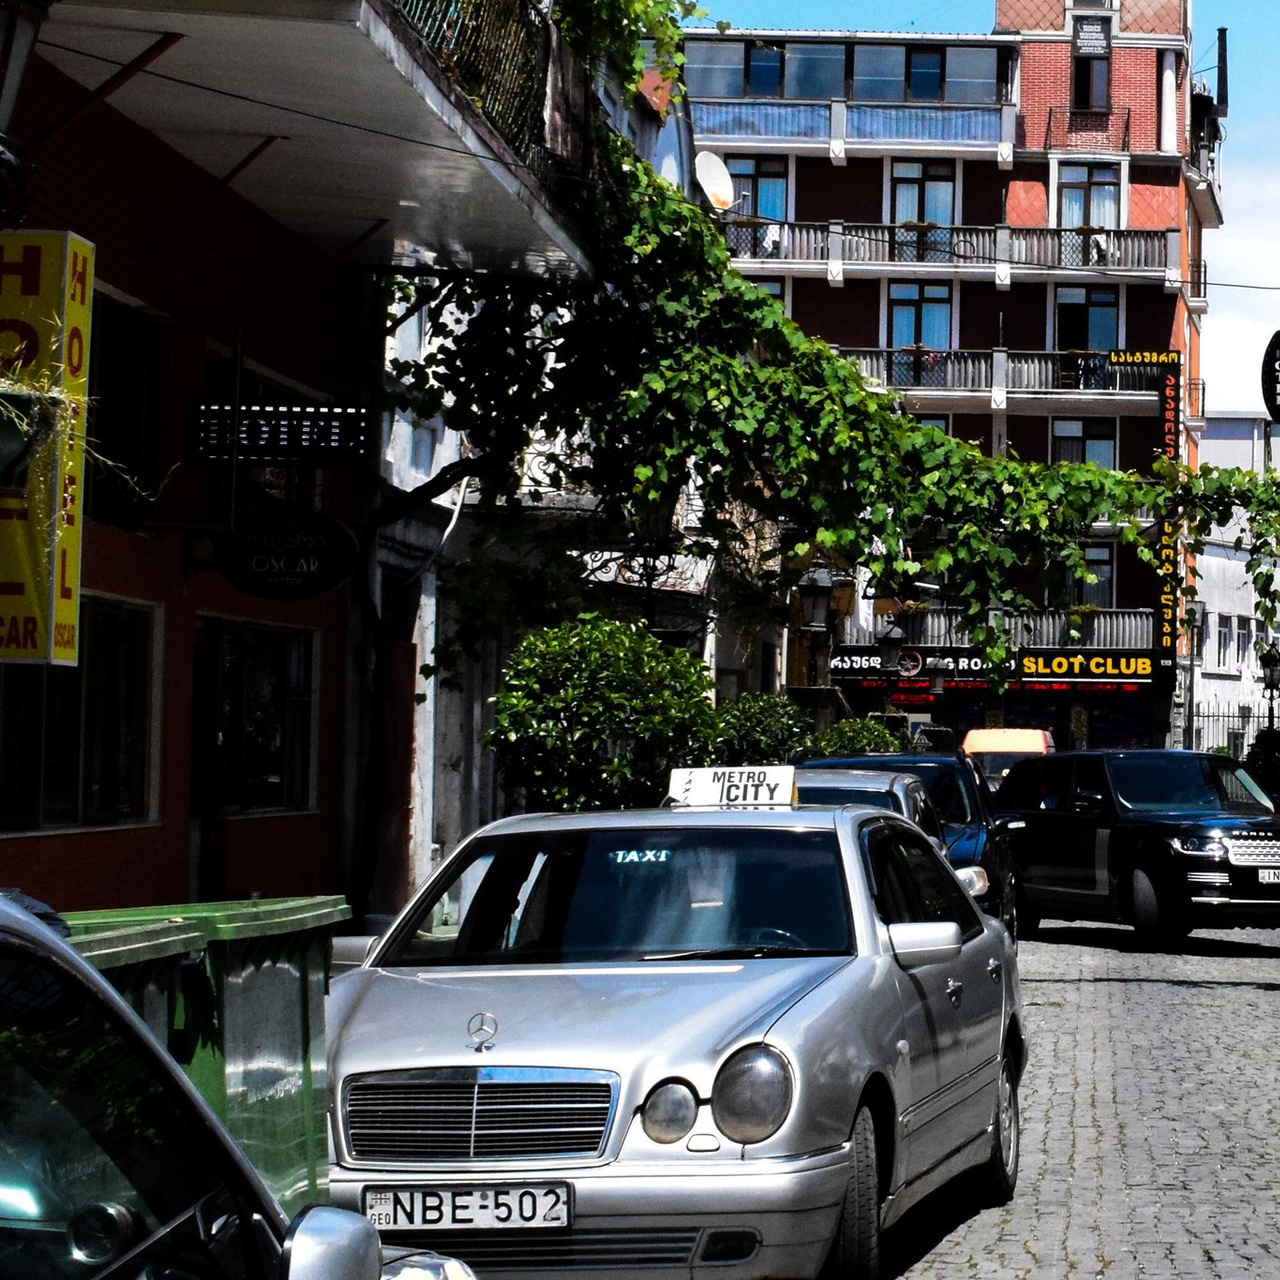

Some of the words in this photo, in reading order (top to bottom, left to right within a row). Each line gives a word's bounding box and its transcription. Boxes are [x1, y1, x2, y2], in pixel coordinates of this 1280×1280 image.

[1110, 350, 1179, 364] სასტუმრო
[251, 554, 320, 575] OSCAR
[1022, 656, 1085, 674] SLOT
[1089, 656, 1152, 675] CLUB
[712, 771, 767, 784] METRO
[726, 783, 780, 803] CITY
[615, 849, 670, 863] TAXI
[393, 1188, 562, 1225] NBE-502
[370, 1212, 391, 1225] GEO
